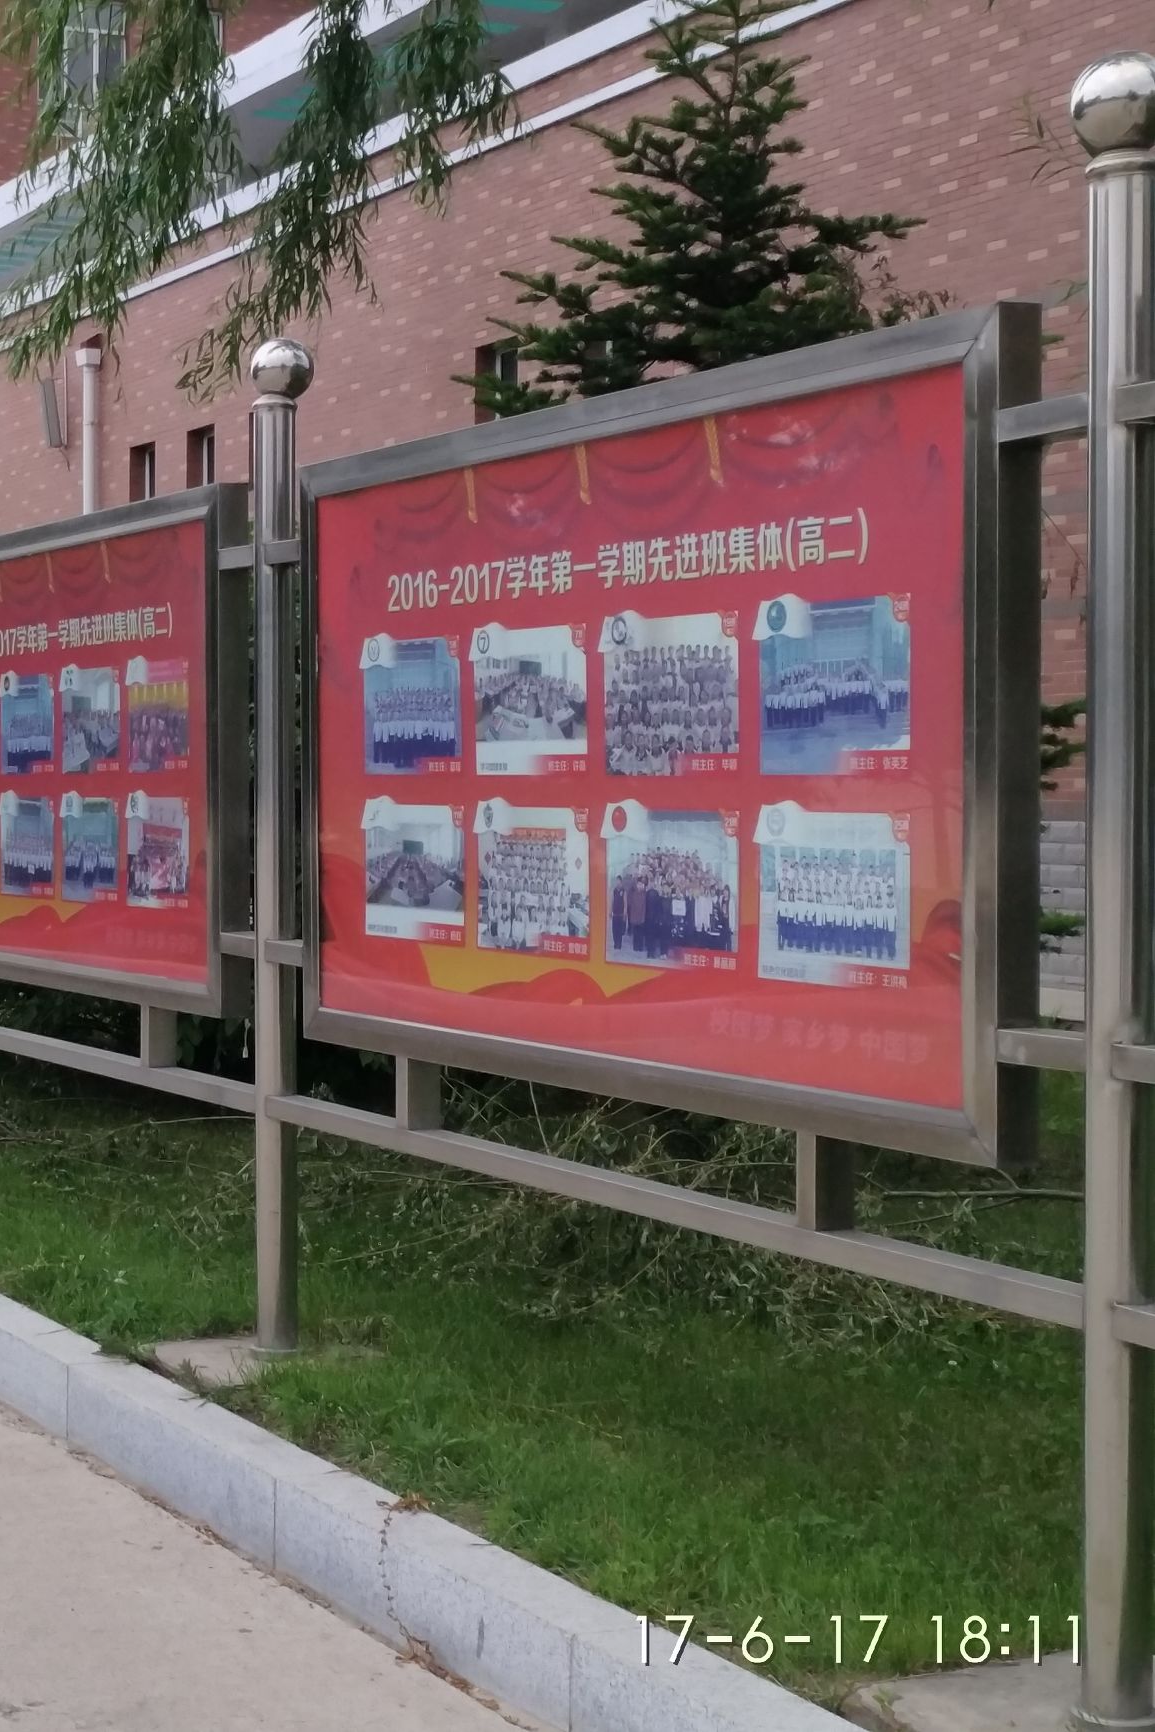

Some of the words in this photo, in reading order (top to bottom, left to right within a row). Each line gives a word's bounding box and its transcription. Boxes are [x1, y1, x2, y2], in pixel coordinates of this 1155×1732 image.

[387, 507, 869, 612] 2016-2017学年第一学期先进班集体(高二)
